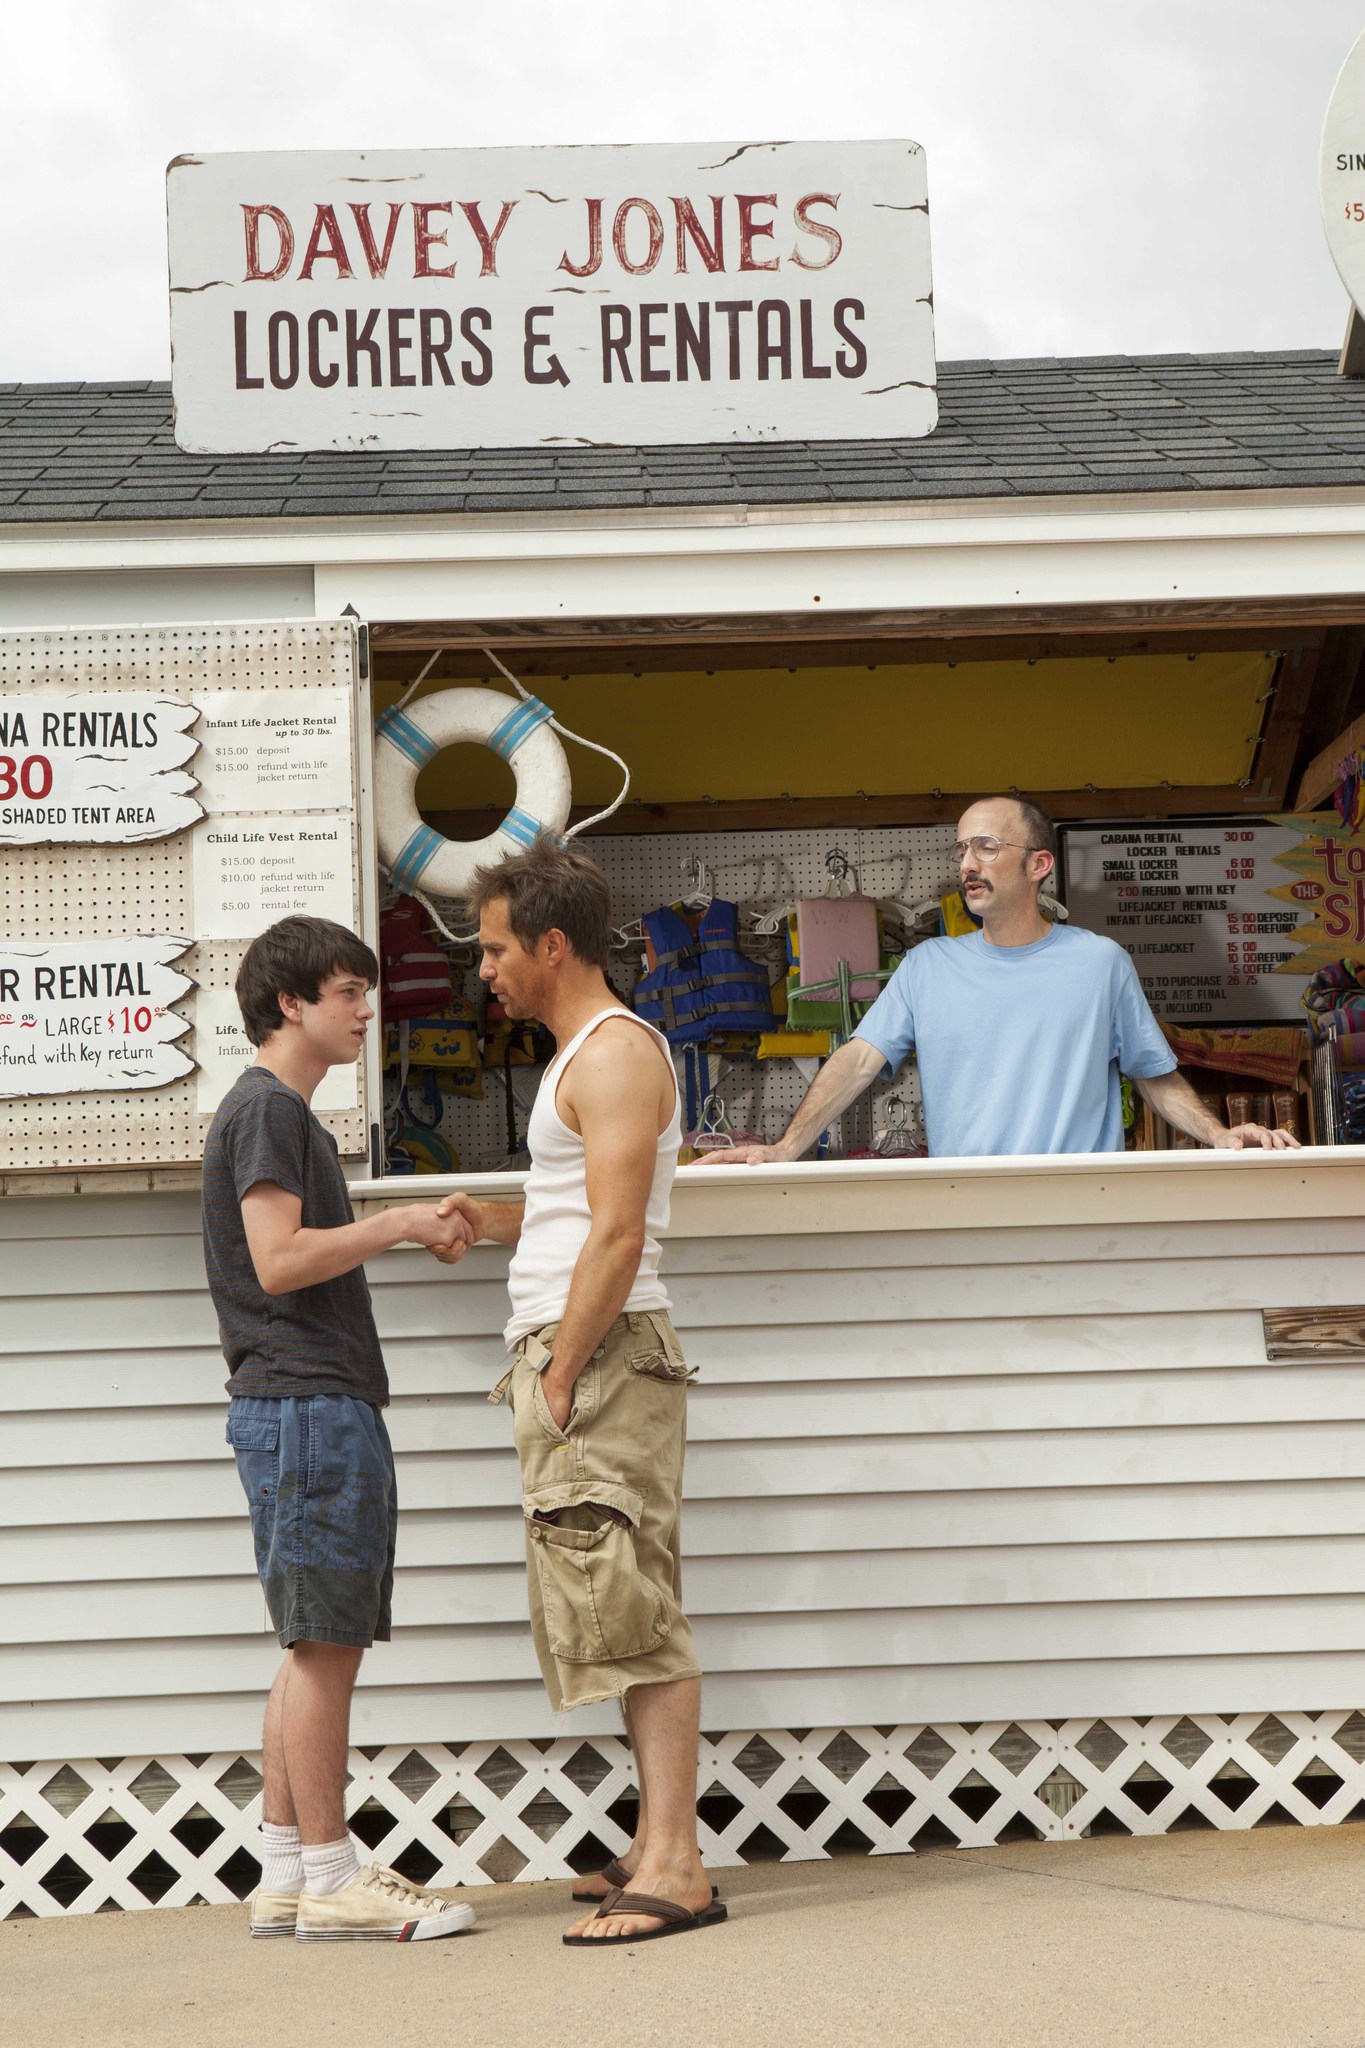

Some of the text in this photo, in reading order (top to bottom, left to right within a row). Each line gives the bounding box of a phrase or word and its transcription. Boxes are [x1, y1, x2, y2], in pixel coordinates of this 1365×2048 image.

[239, 191, 843, 283] DAVEY JONES
[234, 297, 868, 390] LOCKERS & RENTALS
[206, 716, 337, 729] Infant Life Jacket Rental
[42, 712, 158, 748] RENTALS
[275, 730, 288, 738] up
[290, 729, 300, 737] to
[302, 728, 314, 736] 30
[215, 746, 291, 757] $15.00 deposit
[215, 760, 328, 772] $15.00 refund with life
[256, 773, 318, 784] jacket return
[2, 806, 156, 825] SHADED TENT AREA
[207, 831, 338, 844] Child Life Vest Rental
[1101, 833, 1142, 845] CABANA
[1144, 832, 1183, 844] RENTAL
[1127, 845, 1221, 857] LOCKER RENTALS
[220, 856, 295, 867] $15.00 deposit
[1102, 860, 1136, 871] SMALL
[1139, 859, 1178, 870] LOCKER
[221, 871, 335, 883] $10.00 refund with life
[1104, 871, 1136, 882] LARGE
[1139, 870, 1179, 881] LOCKER
[259, 883, 325, 895] jacket return
[1142, 886, 1181, 897] REFUND
[1185, 885, 1213, 895] WITH
[1216, 884, 1236, 895] KEY
[1295, 885, 1319, 898] THE
[221, 900, 307, 911] $5.00 rental fee
[1119, 900, 1227, 912] LIFEJACKET RENTALS
[1107, 915, 1142, 926] INFANT
[1145, 914, 1203, 925] LIFEJACKET
[1257, 912, 1299, 923] DEPOSIT
[1138, 943, 1194, 954] LIFEJACKET
[34, 961, 151, 1001] RENTAL
[1156, 977, 1169, 987] TO
[1170, 976, 1222, 987] PURCHASE
[1172, 990, 1193, 1000] ARE
[1197, 989, 1227, 1000] FINAL
[1166, 1003, 1213, 1014] INCLUDED
[45, 1016, 102, 1037] LARGE
[216, 1026, 238, 1035] Life
[44, 1040, 77, 1063] with
[108, 1040, 154, 1061] return
[218, 1045, 254, 1056] Infant
